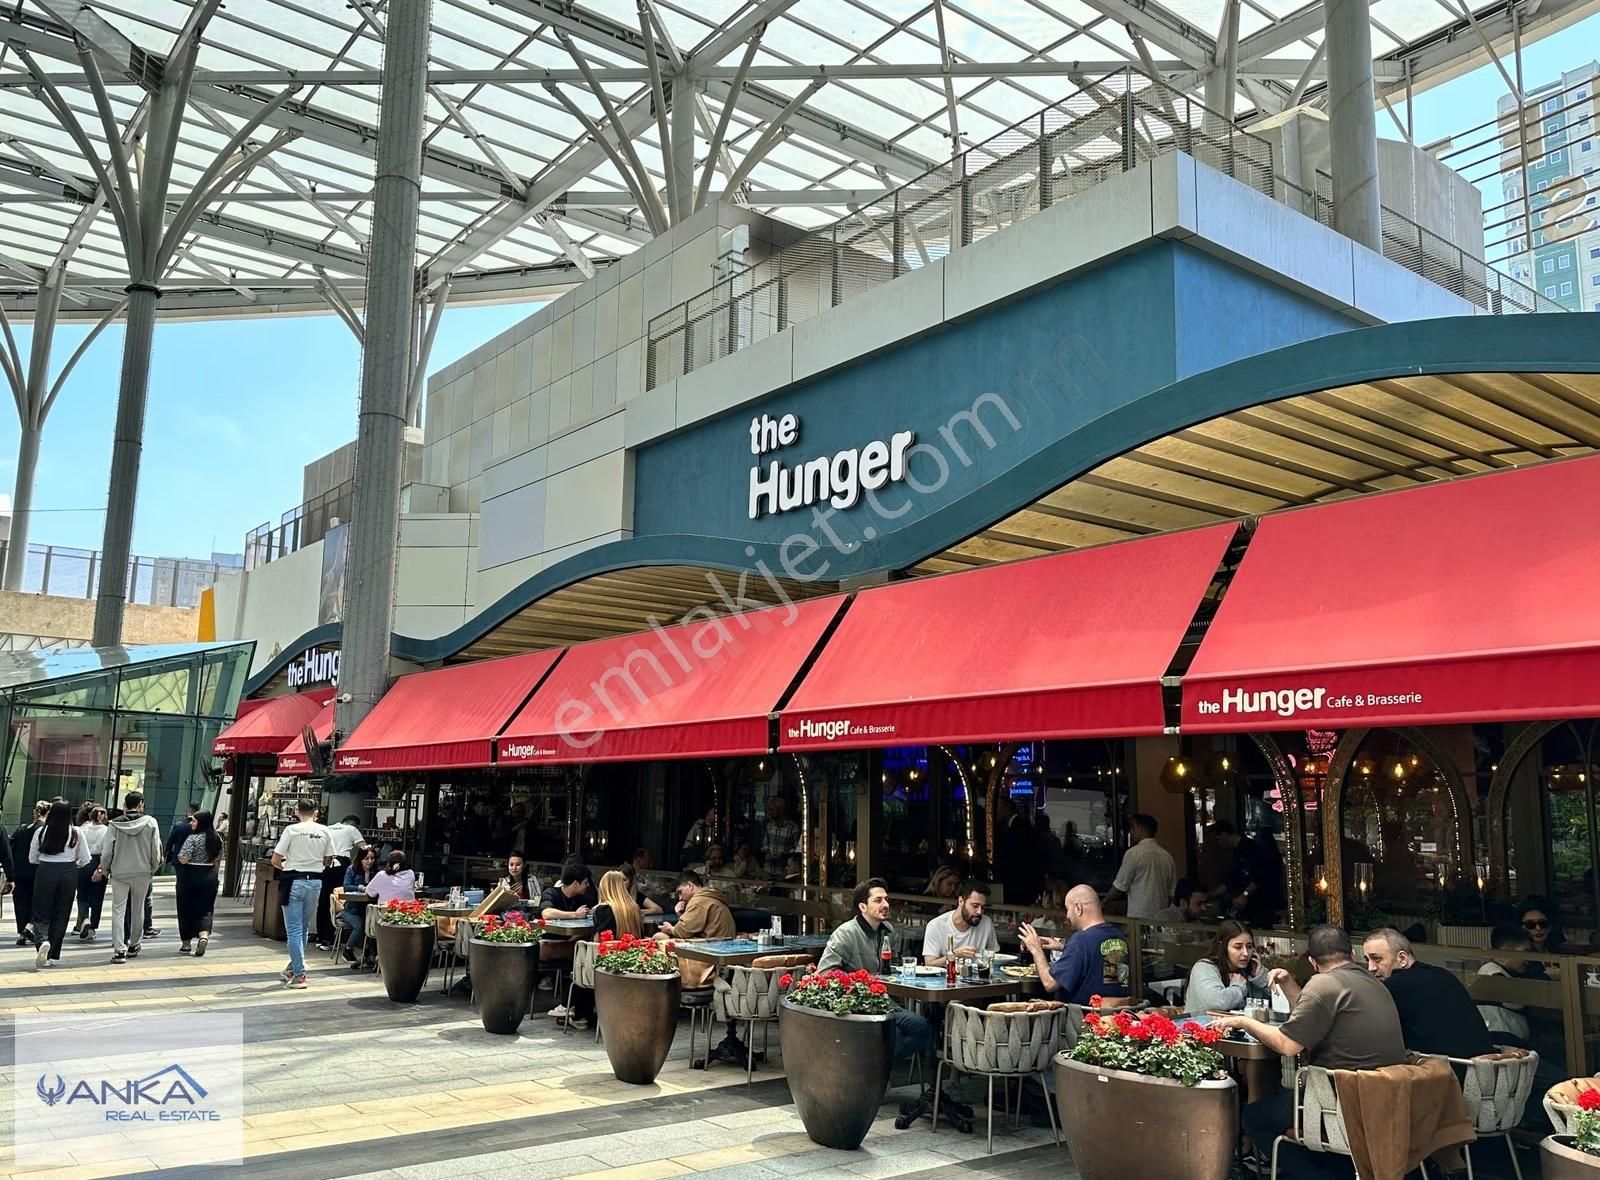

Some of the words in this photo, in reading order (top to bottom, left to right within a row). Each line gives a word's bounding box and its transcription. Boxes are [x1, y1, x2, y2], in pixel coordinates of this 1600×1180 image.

[749, 413, 799, 455] the
[748, 430, 916, 519] Hunger
[288, 662, 304, 687] the
[304, 648, 342, 687] Hung
[1198, 700, 1220, 714] the
[1222, 687, 1326, 716] Hunger
[1327, 697, 1353, 708] Cafe
[1355, 695, 1365, 707] &
[1367, 692, 1422, 706] Brasserie
[788, 728, 799, 738] the
[800, 720, 850, 740] Hunger
[850, 726, 863, 735] Cafe
[869, 725, 895, 734] Brasserie
[508, 743, 534, 759] Hunger
